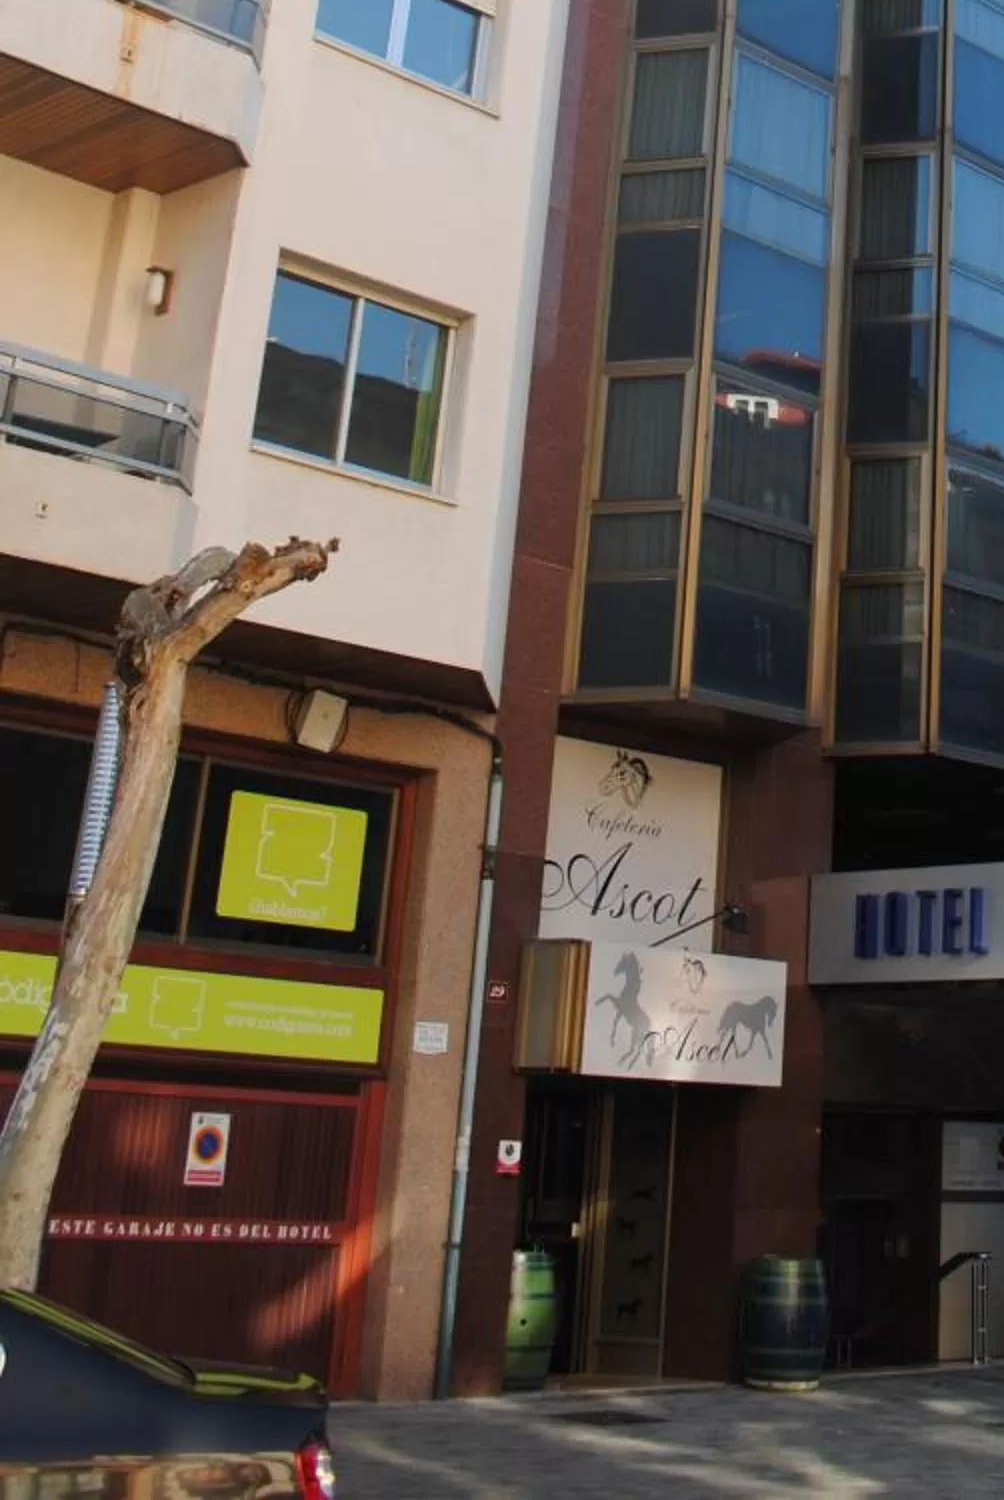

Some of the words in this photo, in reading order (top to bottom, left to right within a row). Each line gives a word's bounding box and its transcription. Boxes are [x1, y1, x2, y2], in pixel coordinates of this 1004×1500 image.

[543, 842, 706, 927] Ascot
[854, 887, 990, 960] HOTEL
[49, 1219, 96, 1235] ESTE
[102, 1221, 176, 1238] GARAJE
[181, 1223, 205, 1238] NO
[211, 1223, 233, 1238] ES
[239, 1223, 272, 1239] DEL
[277, 1224, 333, 1240] HOTEL
